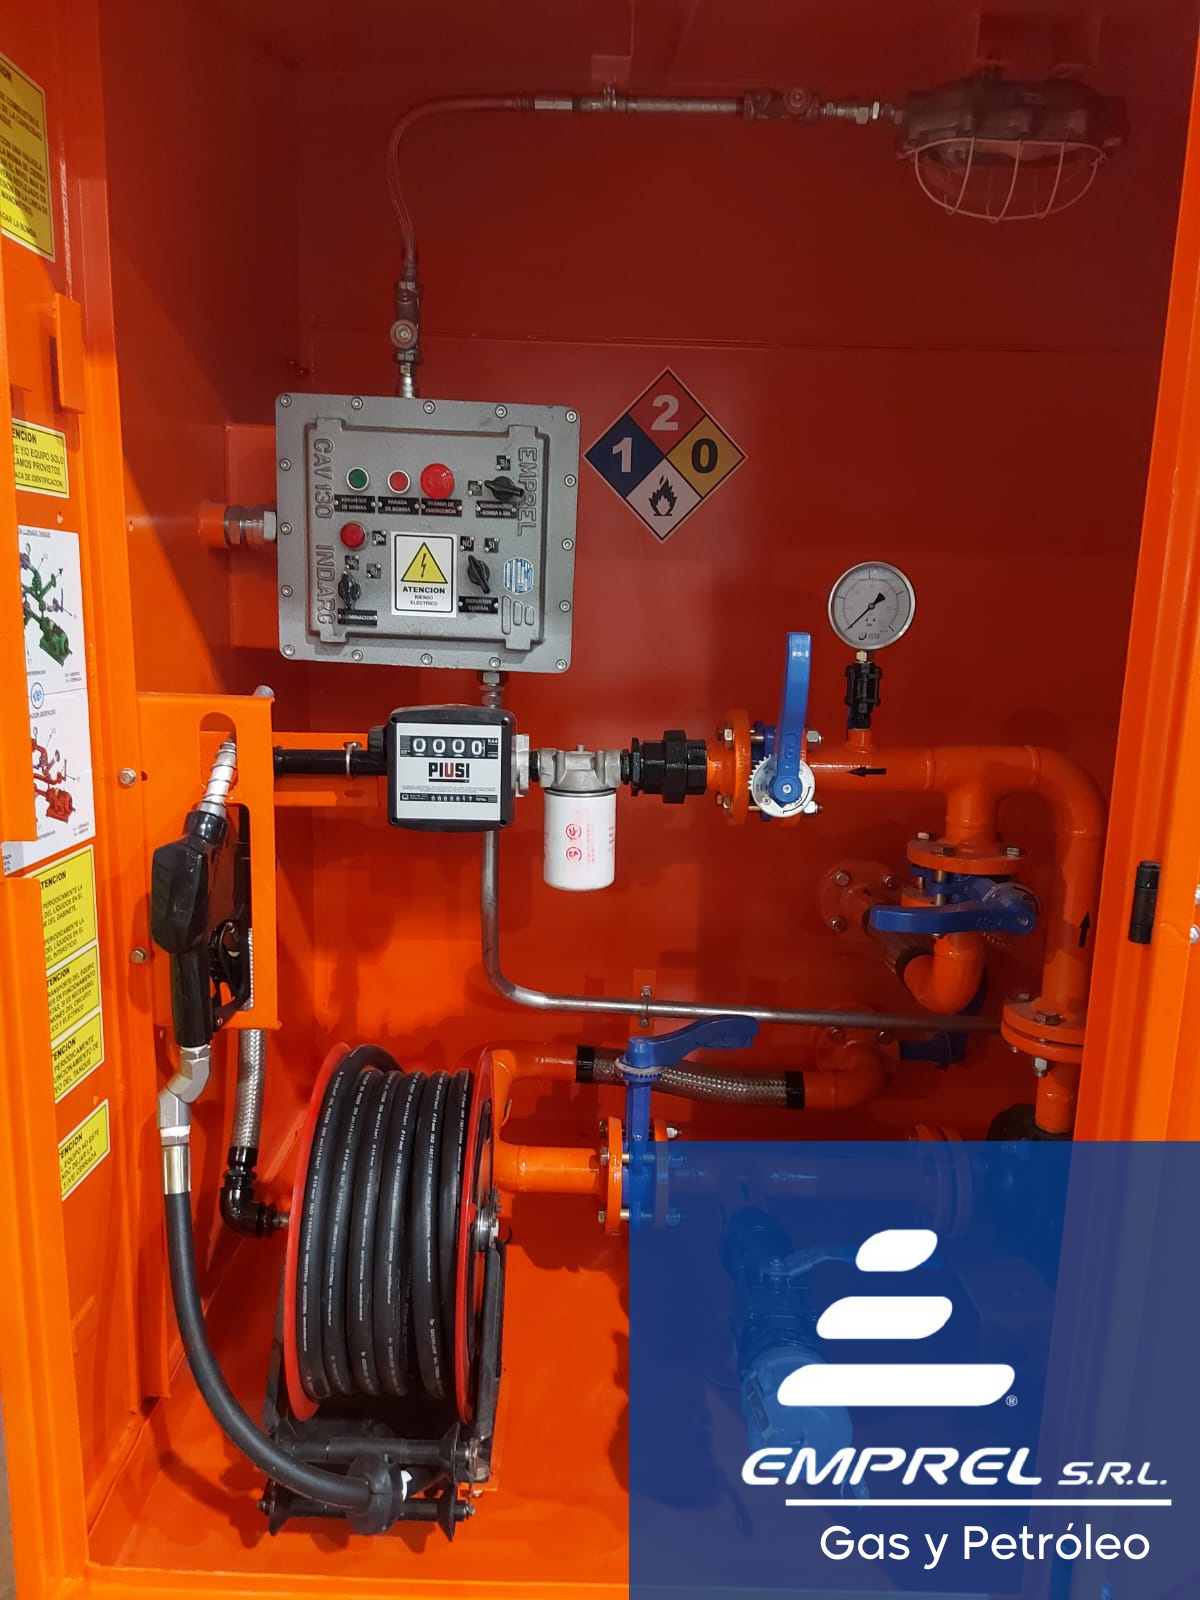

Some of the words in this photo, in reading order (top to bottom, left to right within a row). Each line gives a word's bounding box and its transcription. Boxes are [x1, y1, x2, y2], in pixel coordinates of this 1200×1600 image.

[651, 394, 679, 431] 2
[313, 438, 334, 480] CAV
[612, 437, 633, 473] 1
[691, 438, 718, 474] 0
[314, 483, 335, 520] 130
[517, 446, 538, 536] EMPREL
[402, 586, 446, 594] ATENCION
[428, 762, 470, 778] PIUSI
